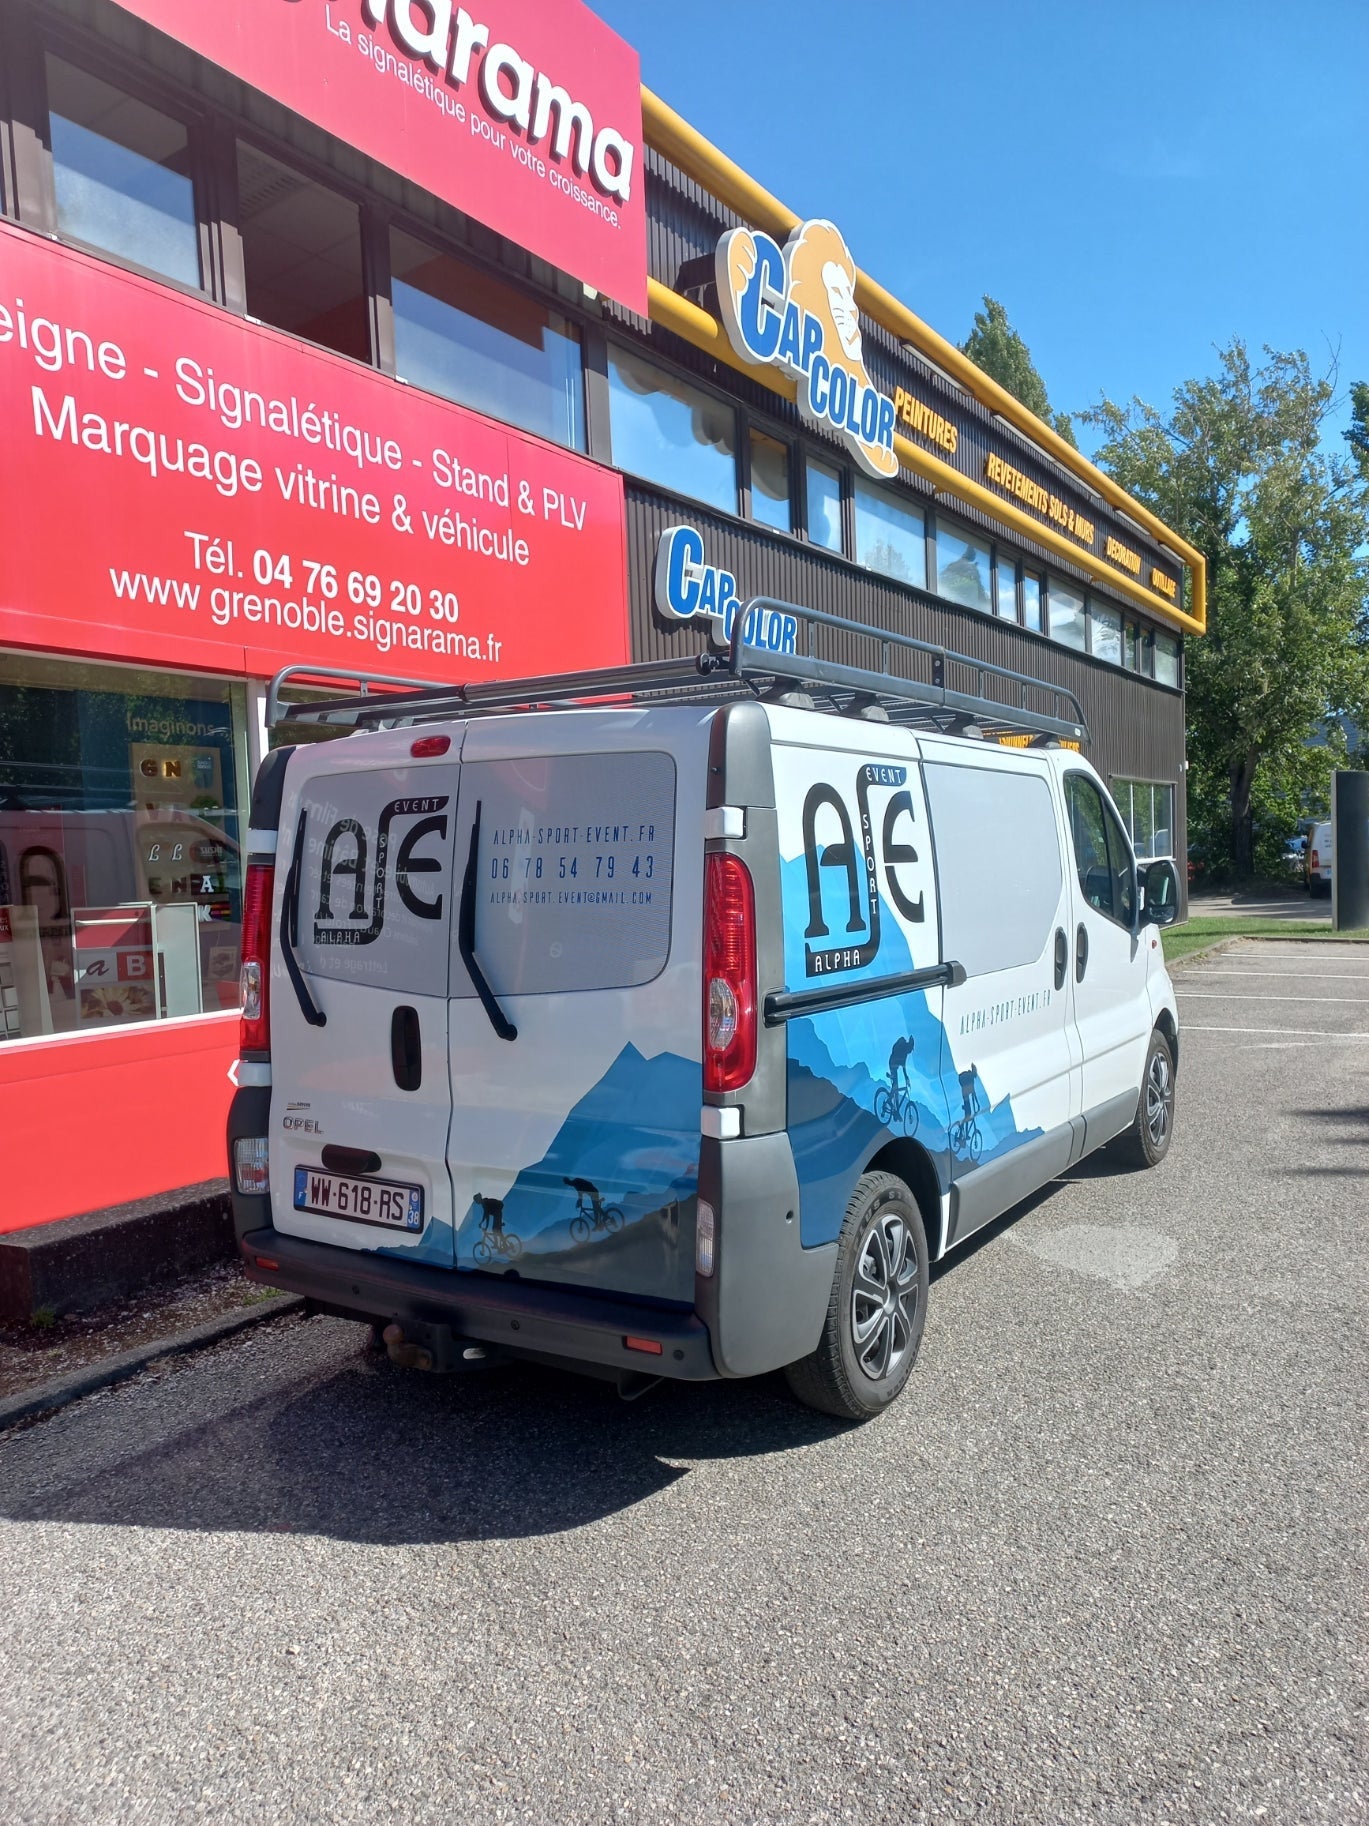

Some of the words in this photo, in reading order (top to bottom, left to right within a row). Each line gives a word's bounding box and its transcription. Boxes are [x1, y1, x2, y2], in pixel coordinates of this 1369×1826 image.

[325, 4, 352, 45] La
[357, 33, 466, 123] signalétique
[471, 112, 507, 151] pour
[510, 139, 546, 178] votre
[549, 168, 622, 230] croissance.
[360, 0, 634, 206] arama
[809, 355, 895, 449] COLOR
[895, 386, 958, 454] PEINTURES
[30, 386, 263, 497] Marquage
[276, 464, 380, 525] vitrine
[391, 494, 414, 535] &
[421, 507, 530, 566] véhicule
[175, 357, 403, 471] Signalétique
[432, 448, 509, 508] Stand
[517, 480, 535, 516] &
[543, 487, 587, 532] PLV
[988, 452, 1049, 515] REVETEMENTS
[1049, 494, 1068, 528] SOLS
[1068, 509, 1075, 532] &
[1075, 514, 1095, 545] MURS
[184, 530, 243, 578] Tél.
[252, 549, 293, 589] 04
[302, 559, 338, 599] 76
[347, 570, 381, 607] 69
[389, 580, 422, 616] 20
[429, 589, 459, 623] 30
[394, 799, 440, 812] EVENT
[866, 767, 902, 785] EVENT
[376, 836, 385, 909] SPORT
[491, 857, 509, 879] 06
[525, 857, 543, 879] 78
[559, 856, 578, 879] 54
[596, 855, 615, 878] 79
[632, 855, 654, 878] 43
[862, 813, 877, 915] SPORT
[815, 949, 862, 973] ALPHA
[283, 1115, 324, 1135] OPEL
[408, 1210, 420, 1225] 38
